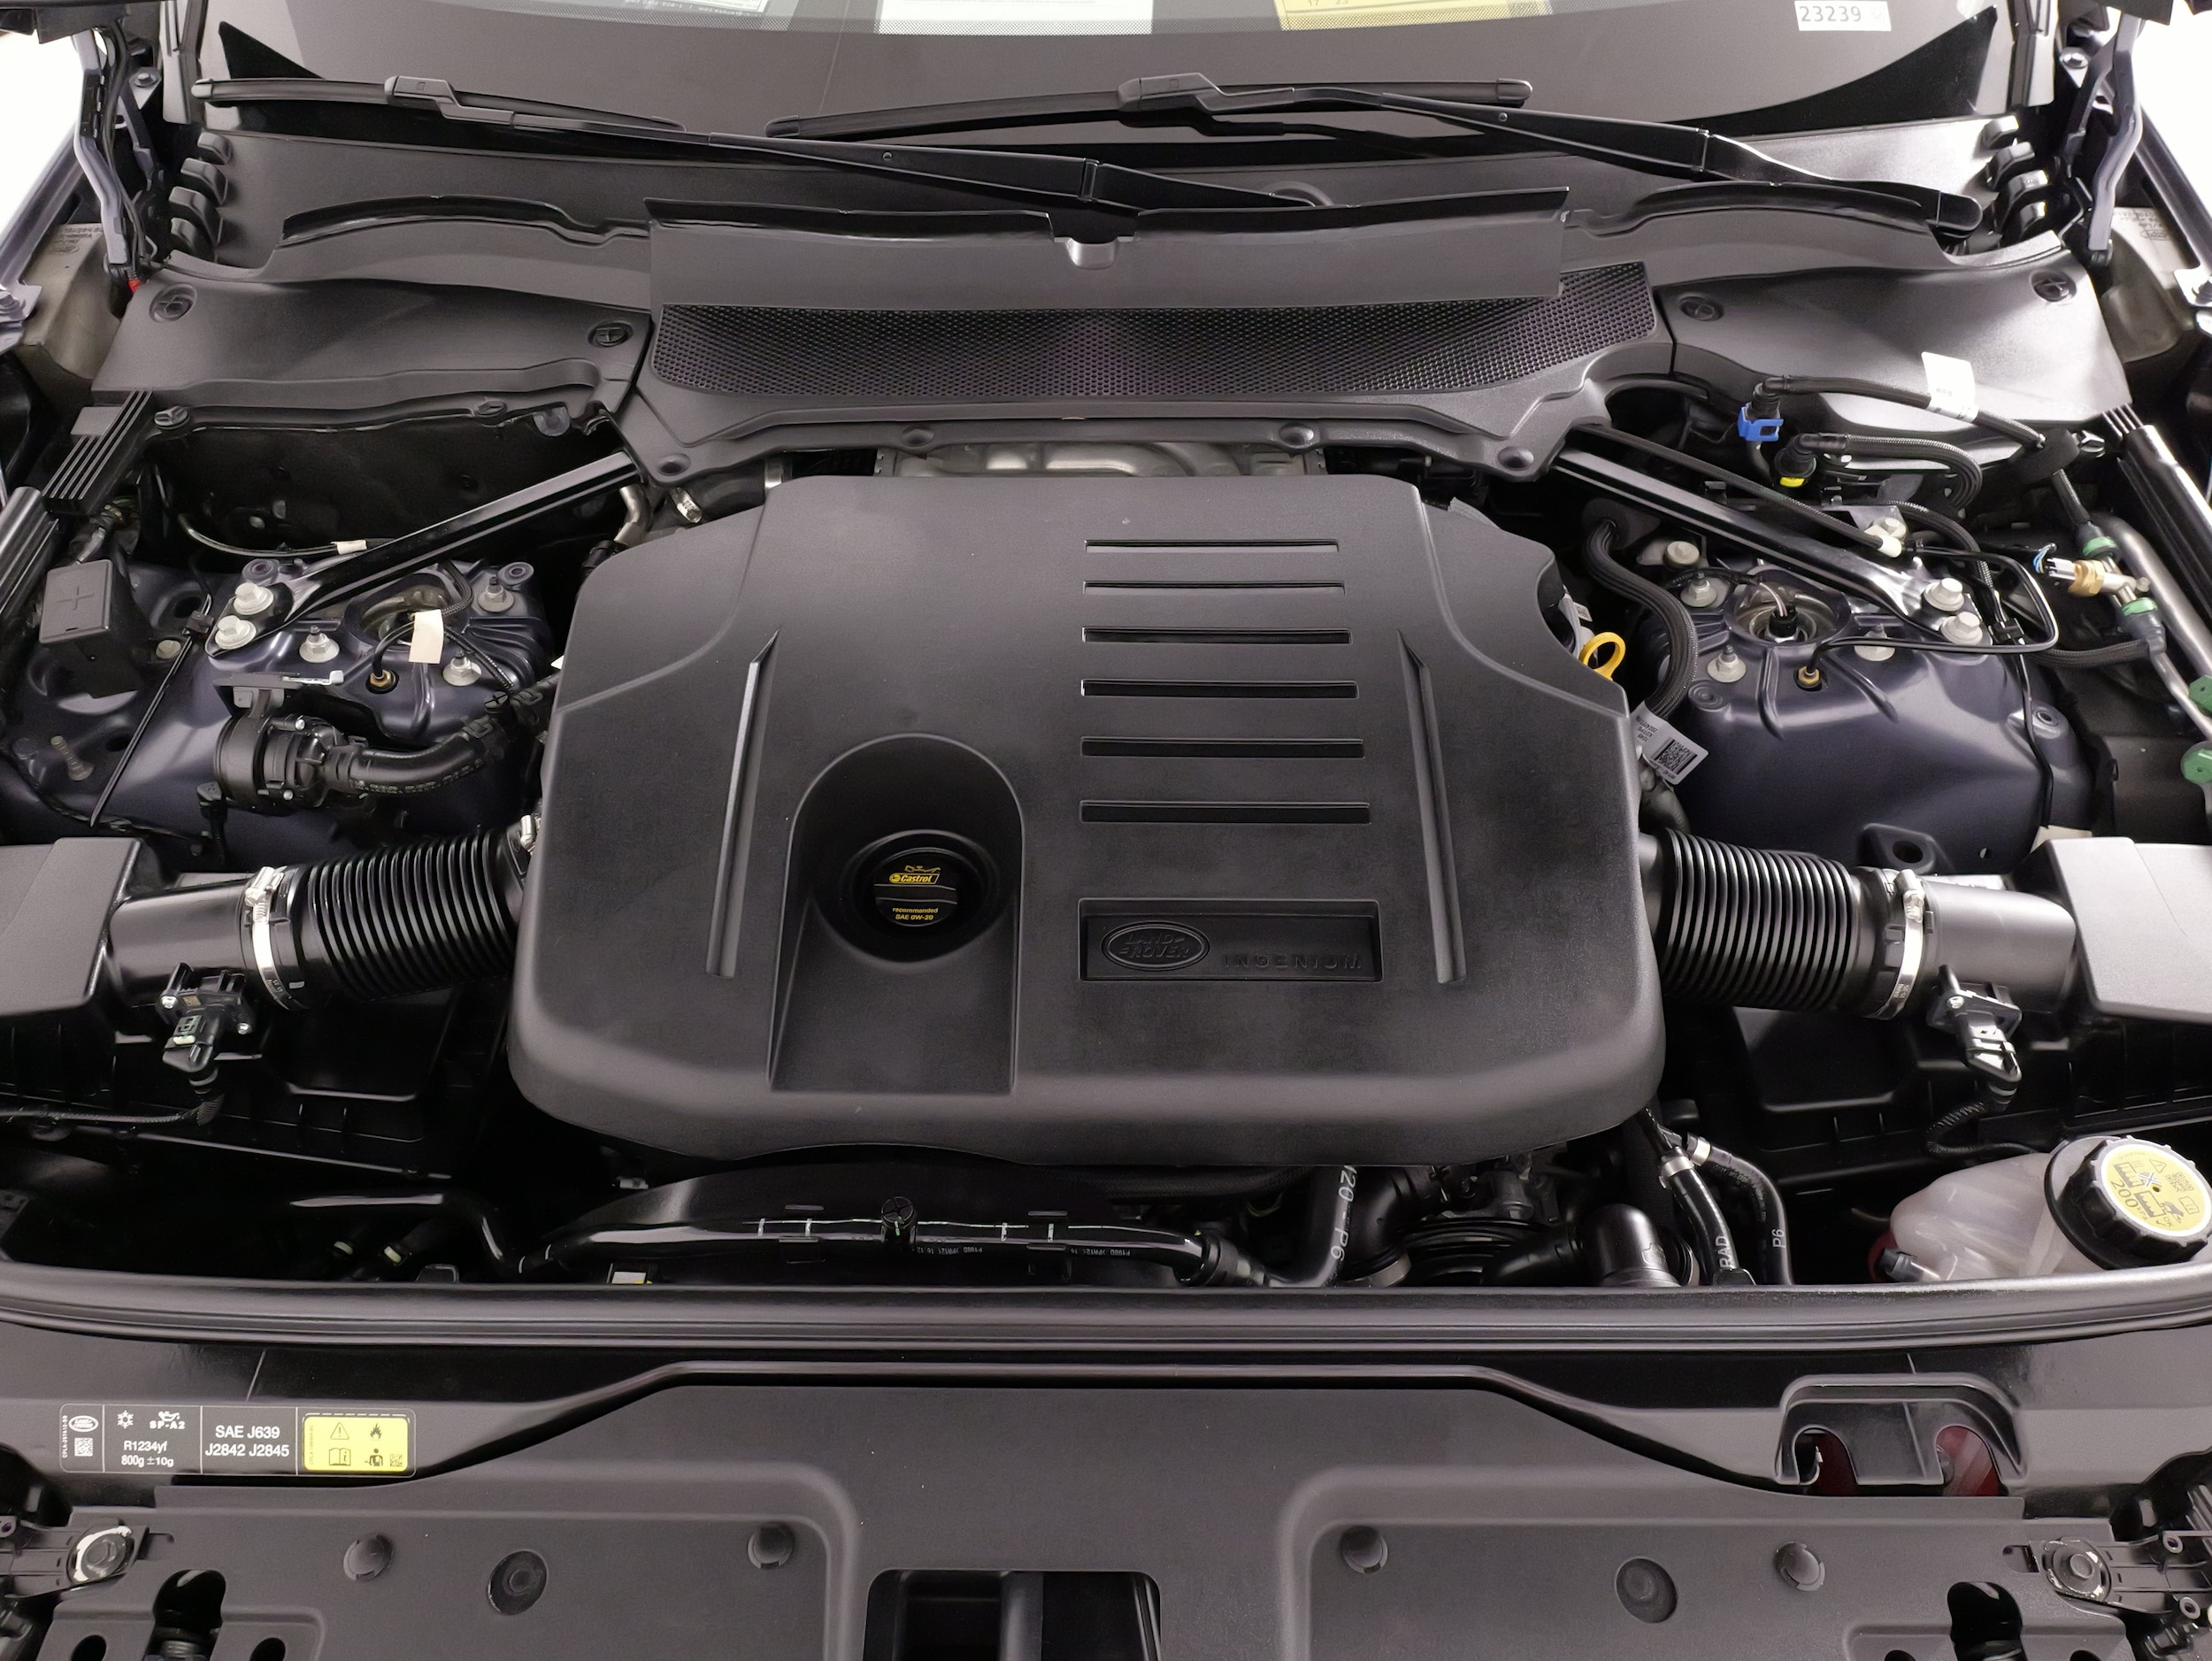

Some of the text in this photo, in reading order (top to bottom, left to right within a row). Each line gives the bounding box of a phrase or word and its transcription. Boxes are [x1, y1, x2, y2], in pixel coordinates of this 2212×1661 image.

[1799, 5, 1862, 22] 23239
[901, 874, 933, 883] Castrol
[1223, 952, 1362, 970] INGENIUM
[2110, 1180, 2139, 1208] 200
[1330, 1227, 1349, 1262] P6
[1771, 1228, 1786, 1249] P6
[1715, 1235, 1736, 1269] RAD
[149, 1420, 186, 1430] SP-A2
[215, 1425, 280, 1440] SAE J639
[123, 1440, 168, 1454] R1234yf
[204, 1442, 290, 1457] J2842 J2845
[121, 1455, 174, 1468] 800g ±10g
